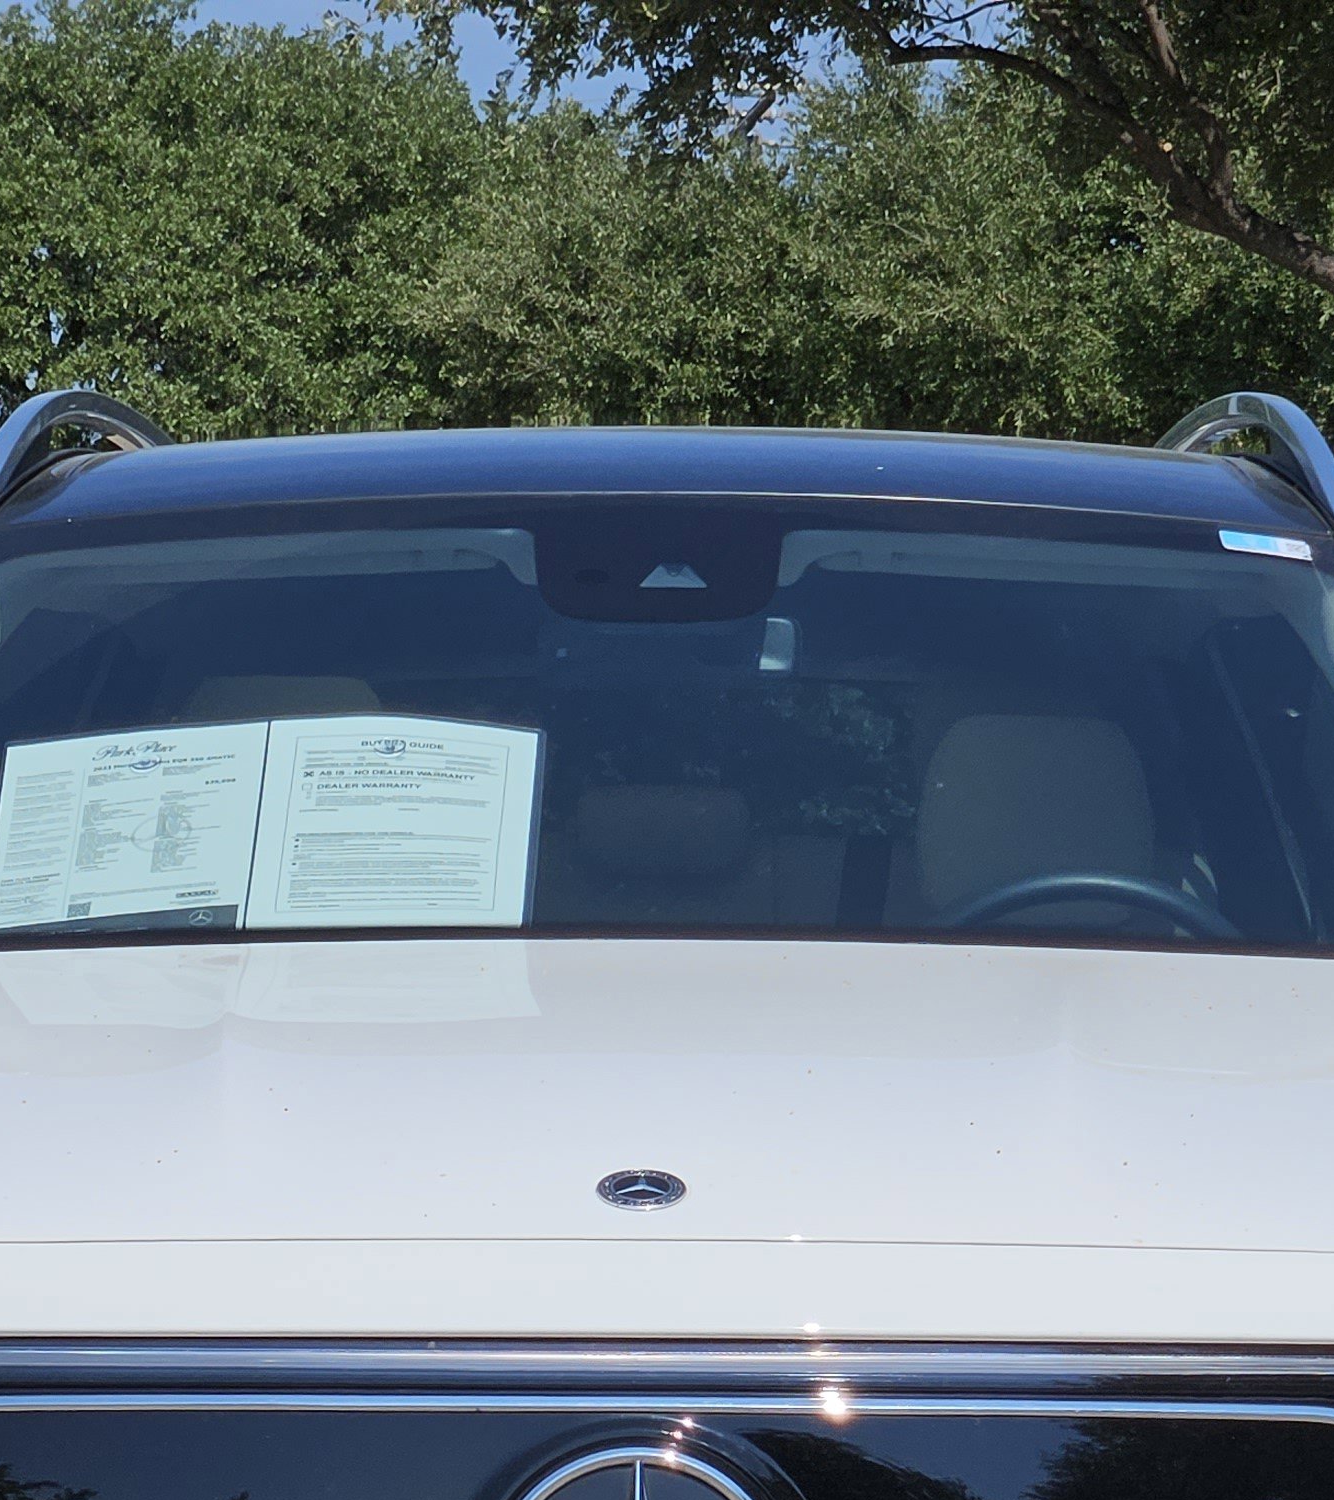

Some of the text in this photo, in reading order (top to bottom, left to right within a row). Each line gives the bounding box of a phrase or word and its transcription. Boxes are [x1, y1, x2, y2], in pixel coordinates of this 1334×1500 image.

[408, 741, 445, 750] GUIDE
[416, 770, 476, 781] WARRANTY
[361, 782, 422, 790] WARRANTY
